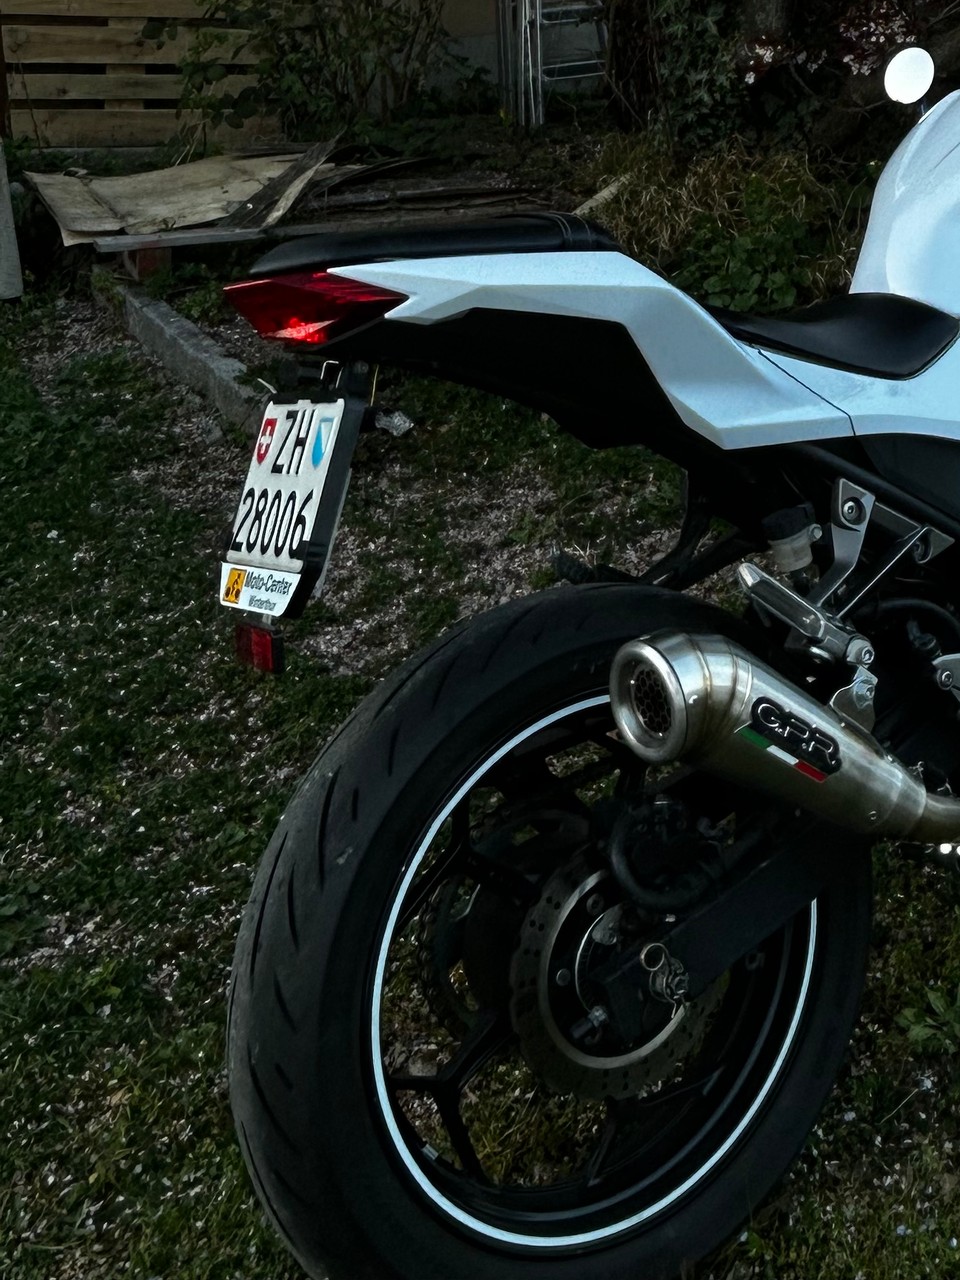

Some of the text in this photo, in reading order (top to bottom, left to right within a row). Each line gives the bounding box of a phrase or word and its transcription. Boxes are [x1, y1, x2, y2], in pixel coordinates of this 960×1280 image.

[271, 409, 316, 476] ZH
[232, 487, 314, 560] 28006
[244, 571, 293, 596] Moto-Center
